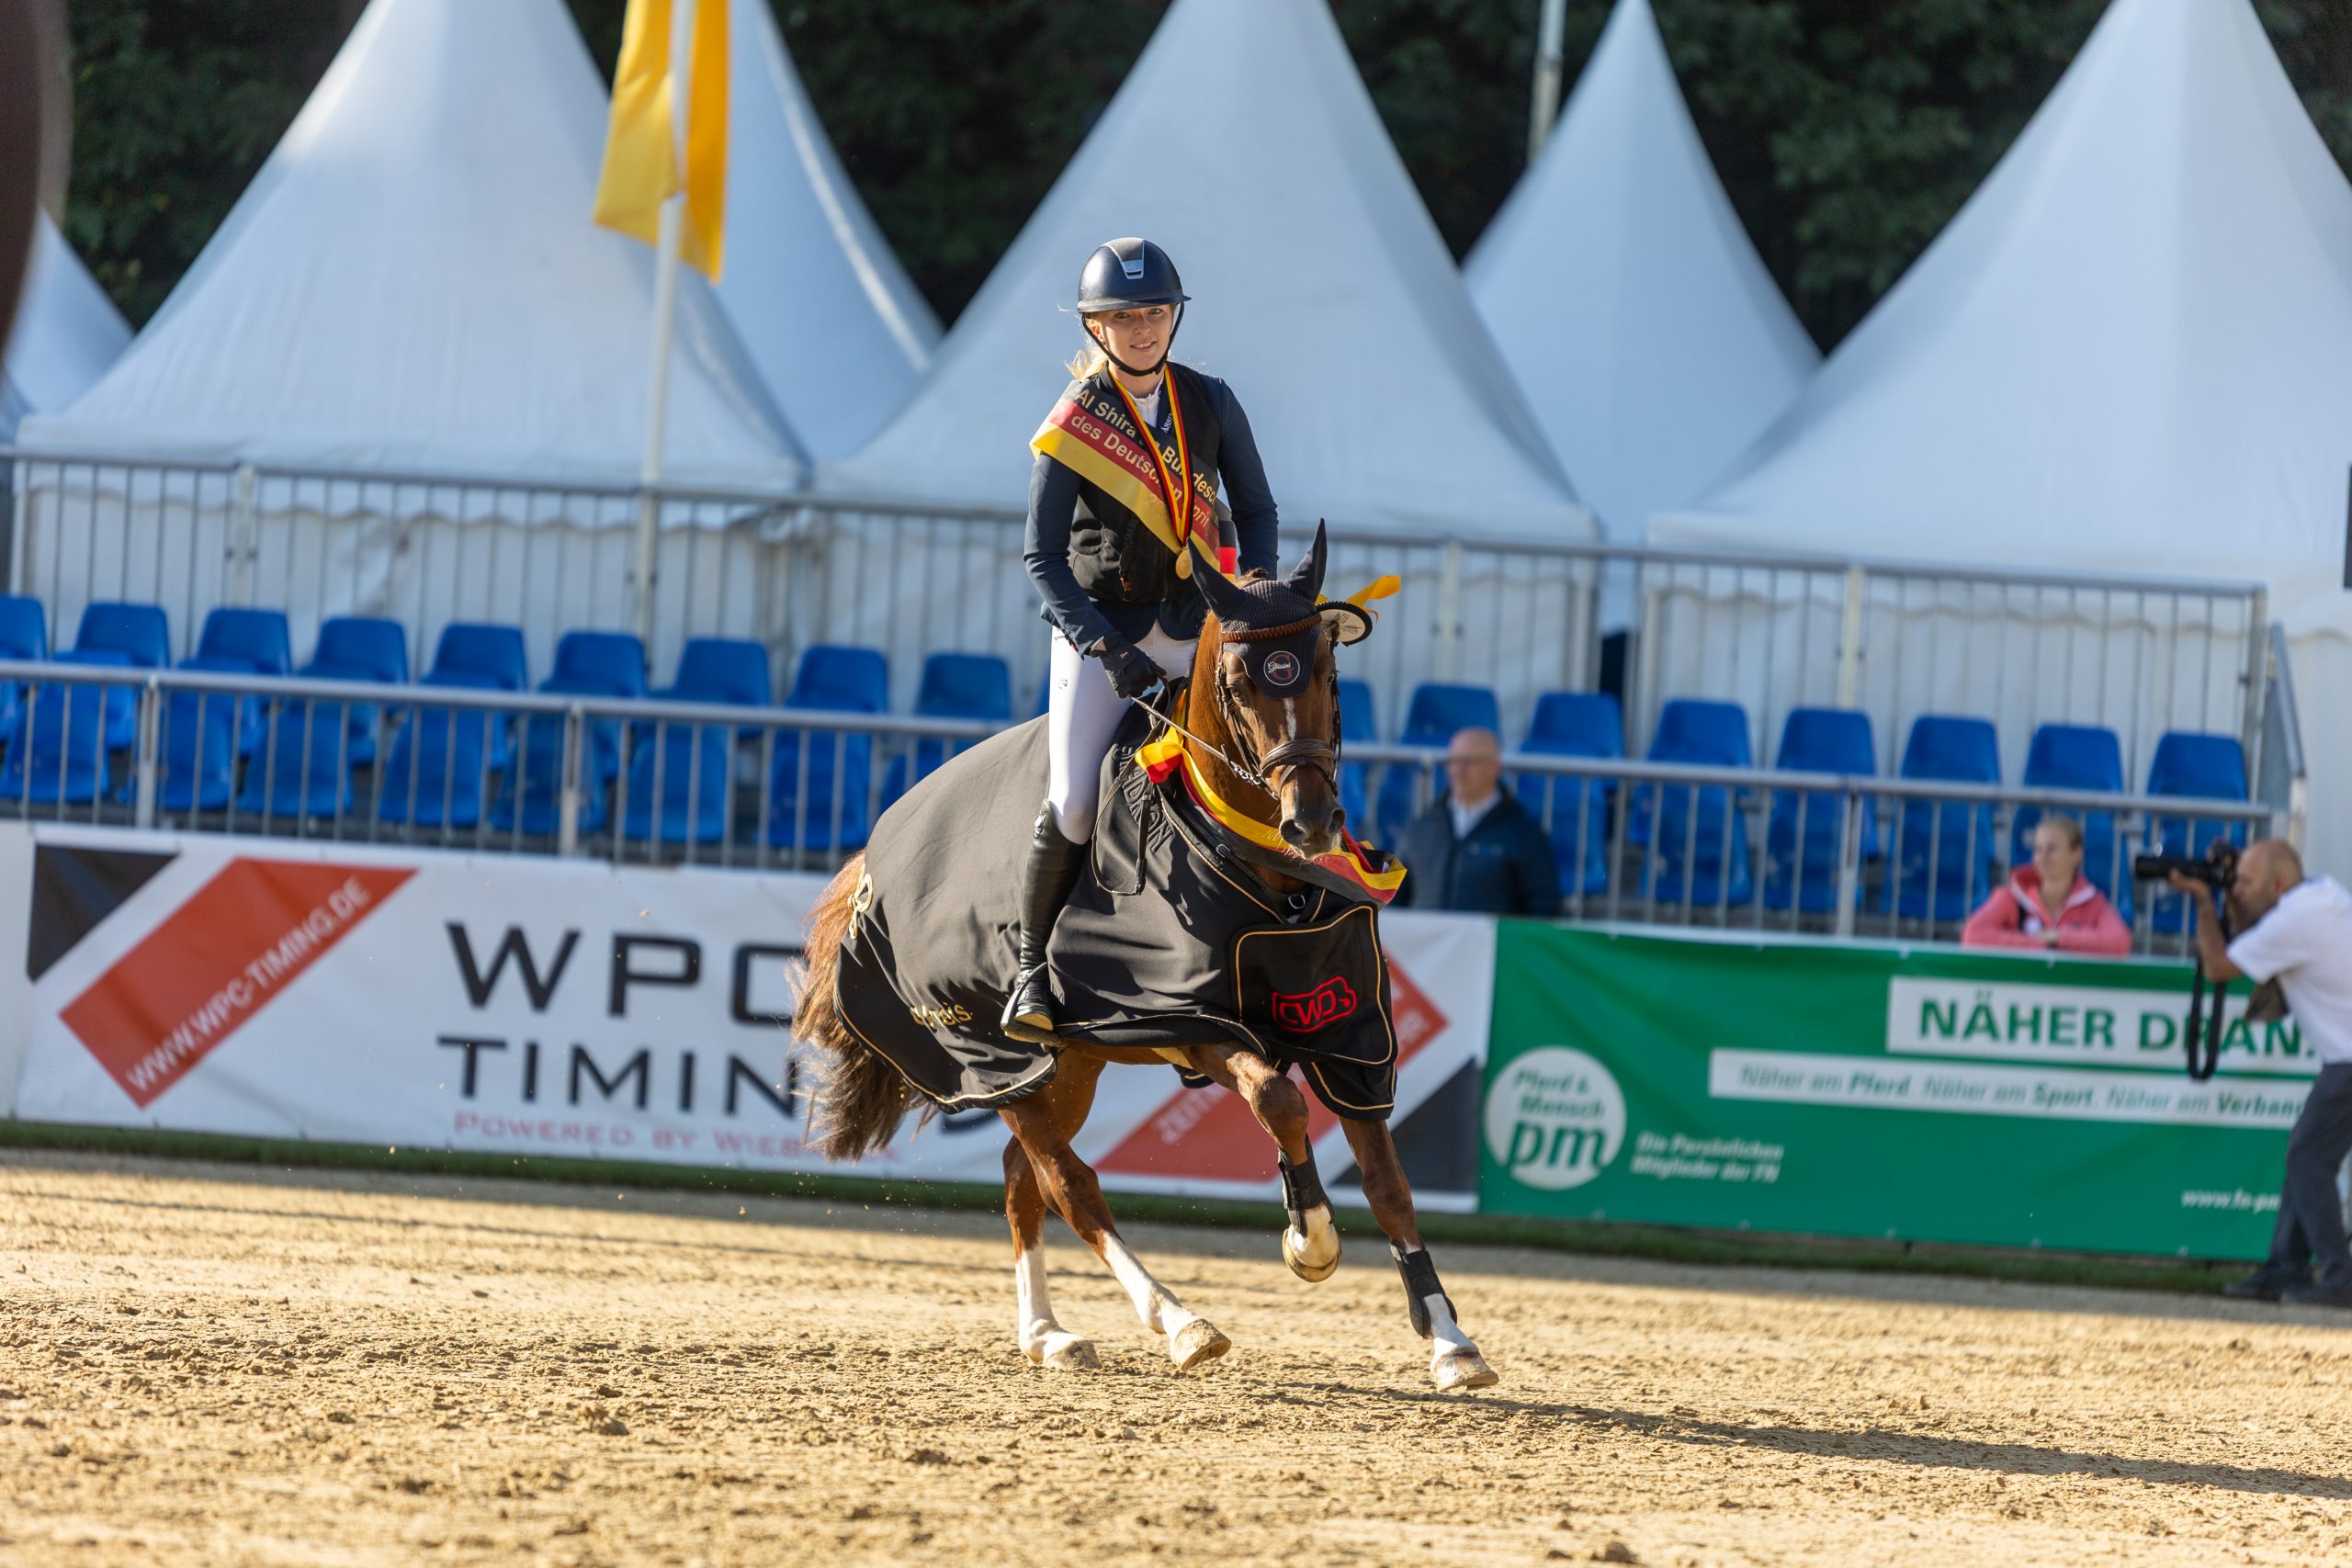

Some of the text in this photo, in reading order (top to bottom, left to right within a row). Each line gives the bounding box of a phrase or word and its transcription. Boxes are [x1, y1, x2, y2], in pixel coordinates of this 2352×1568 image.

[1071, 416, 1102, 440] des
[1103, 433, 1182, 501] Deutscn
[1075, 389, 1216, 504] Al Shira Budesc
[125, 874, 372, 1093] WWW.WPC-TIMING.DE
[446, 923, 810, 1026] WPC
[1279, 990, 1337, 1025] CWD
[1920, 988, 2118, 1049] NÄHER
[1517, 1069, 1573, 1093] Pferd
[1740, 1064, 1804, 1088] Näher
[1810, 1072, 1842, 1092] am
[1925, 1076, 1989, 1099] Näher
[1992, 1084, 2026, 1103] am
[2105, 1088, 2170, 1111] Näher
[2177, 1094, 2210, 1114] am
[454, 1111, 634, 1147] POWERED
[652, 1126, 699, 1151] BY
[1521, 1095, 1605, 1119] Mensch
[1509, 1121, 1606, 1169] pm
[1630, 1155, 1717, 1181] Mitglieder
[1720, 1161, 1749, 1182] der
[1636, 1131, 1785, 1160] Die Persönlichen
